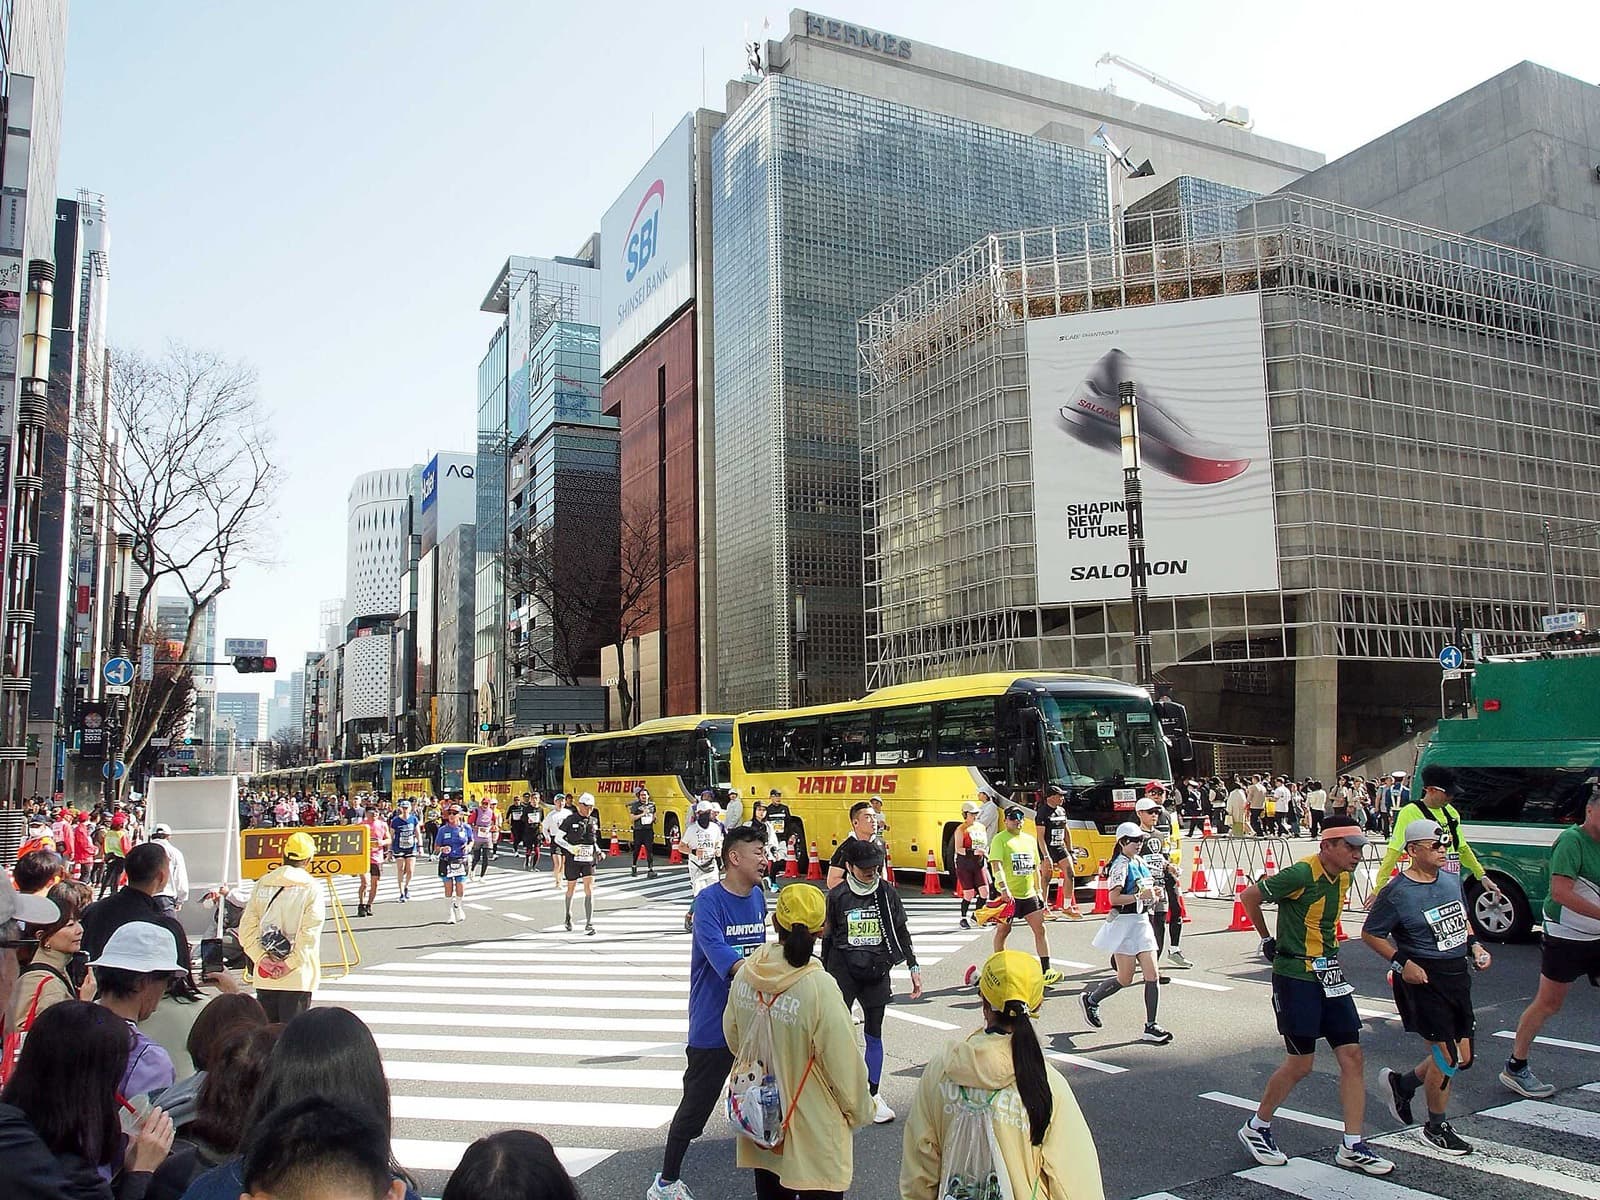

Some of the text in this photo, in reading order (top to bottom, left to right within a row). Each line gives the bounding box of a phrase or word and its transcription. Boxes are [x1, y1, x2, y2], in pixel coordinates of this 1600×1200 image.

[626, 208, 659, 283] SBI
[617, 261, 669, 325] SHINSEI BANK
[1078, 399, 1120, 421] SALOMO
[1067, 515, 1102, 527] NEW
[1099, 725, 1112, 734] 57
[597, 780, 622, 793] HATO
[797, 775, 899, 794] HATO BUS
[267, 859, 342, 874] SKO
